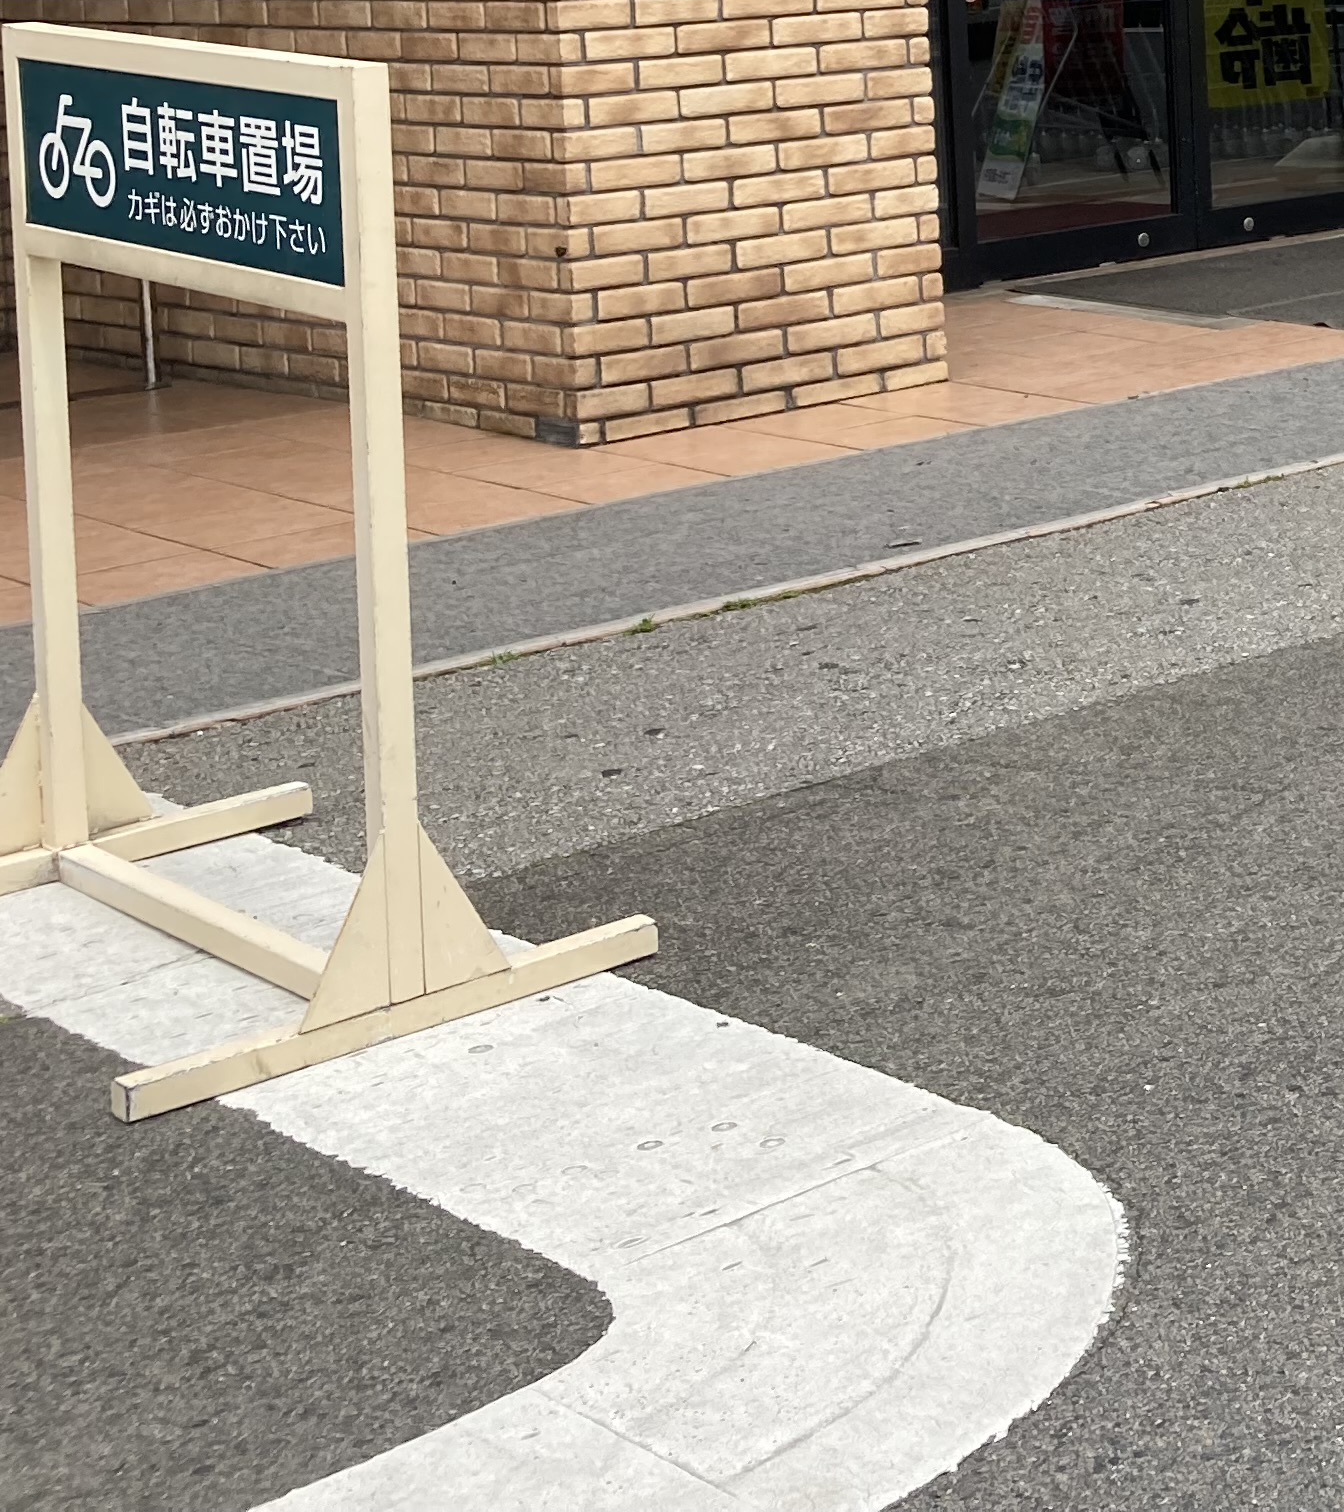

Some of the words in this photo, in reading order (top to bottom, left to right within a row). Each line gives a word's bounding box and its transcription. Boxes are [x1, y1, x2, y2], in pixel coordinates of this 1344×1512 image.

[120, 96, 324, 205] 自転車置場
[127, 188, 327, 255] カギは必ずおかけ下さい
